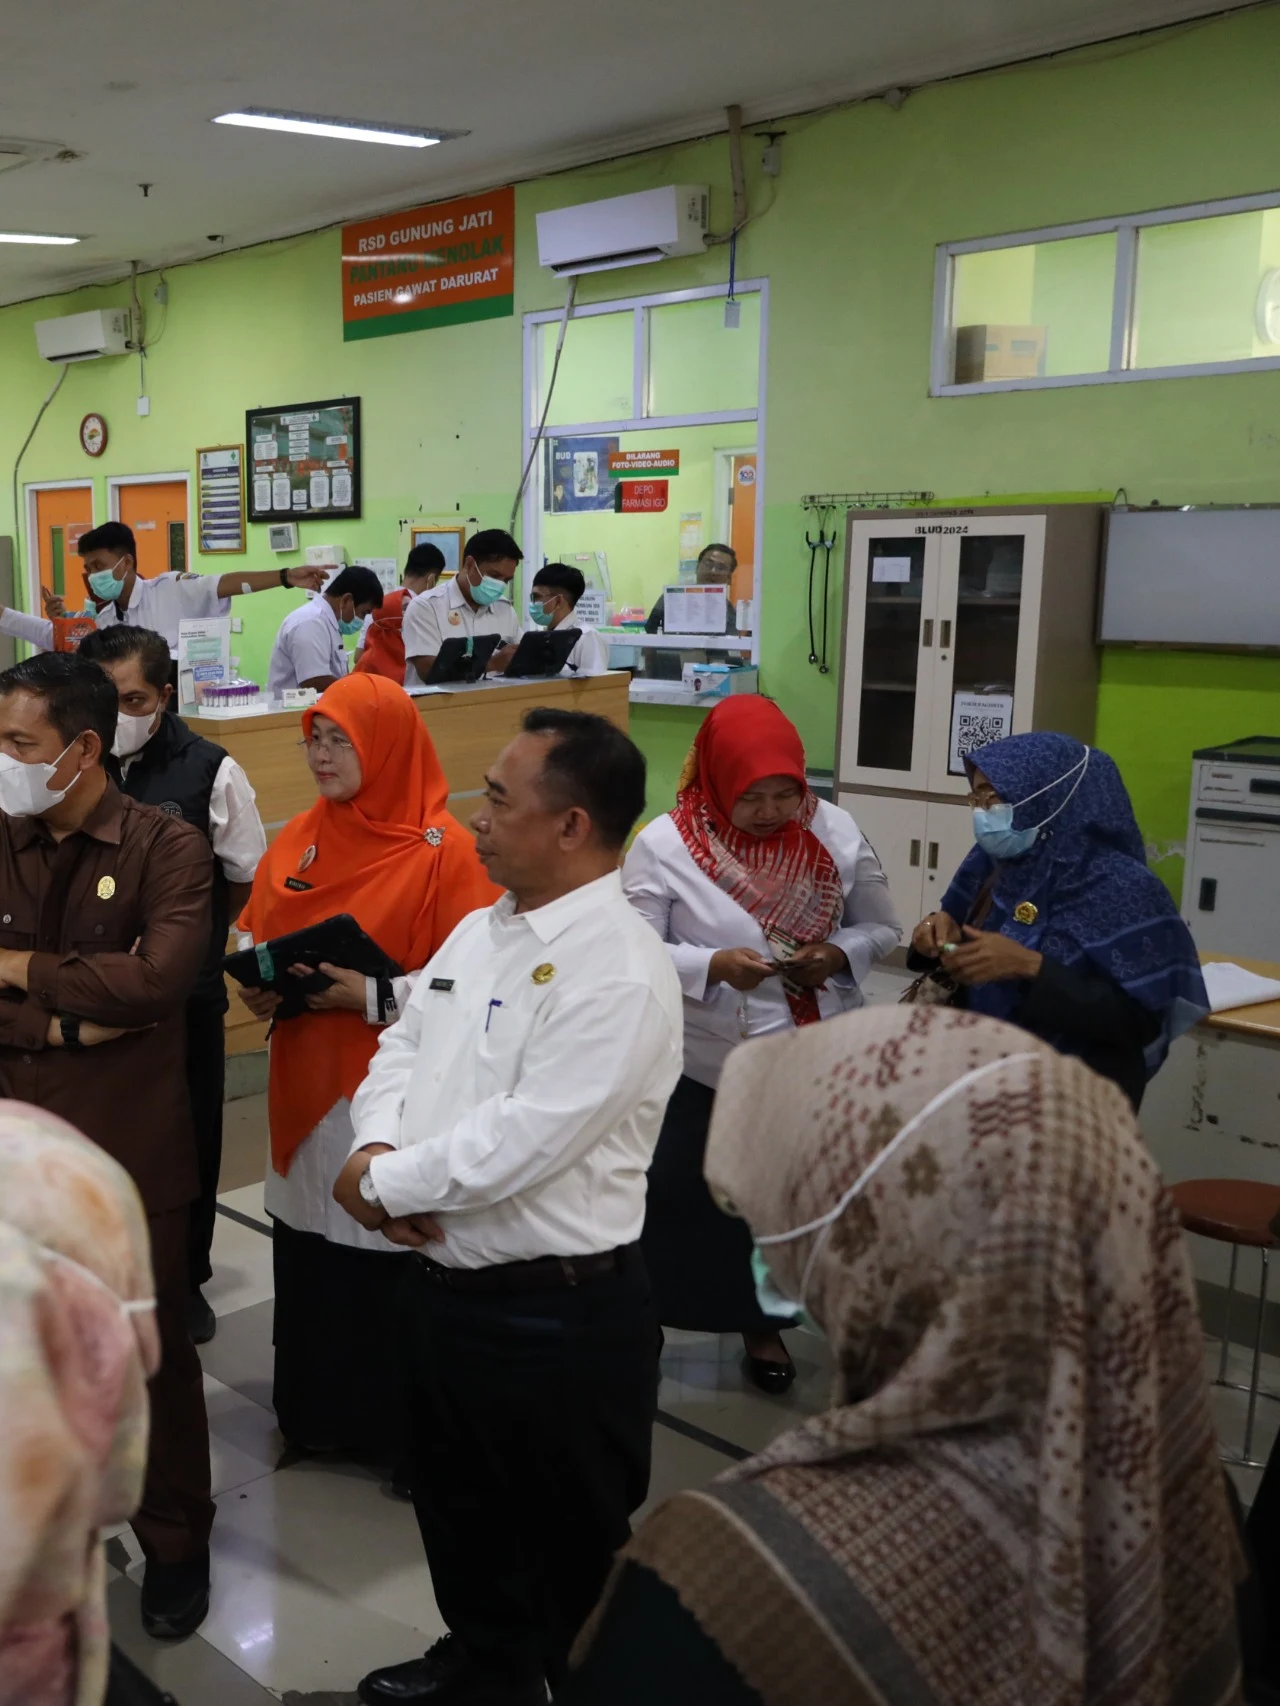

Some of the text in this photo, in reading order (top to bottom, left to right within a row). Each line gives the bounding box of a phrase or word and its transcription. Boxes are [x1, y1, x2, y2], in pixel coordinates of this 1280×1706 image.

[358, 210, 493, 253] RSD GUNUNG JATI
[349, 235, 504, 285] PANTANG MENOLAK
[353, 268, 499, 307] PASIEN GAWAT DARURAT
[555, 451, 571, 460] BUD
[626, 452, 661, 460] DILARANG
[611, 460, 675, 469] FOTO-VIDEO-AUDIO
[634, 484, 654, 495] DEPO
[621, 497, 652, 509] FARMASI
